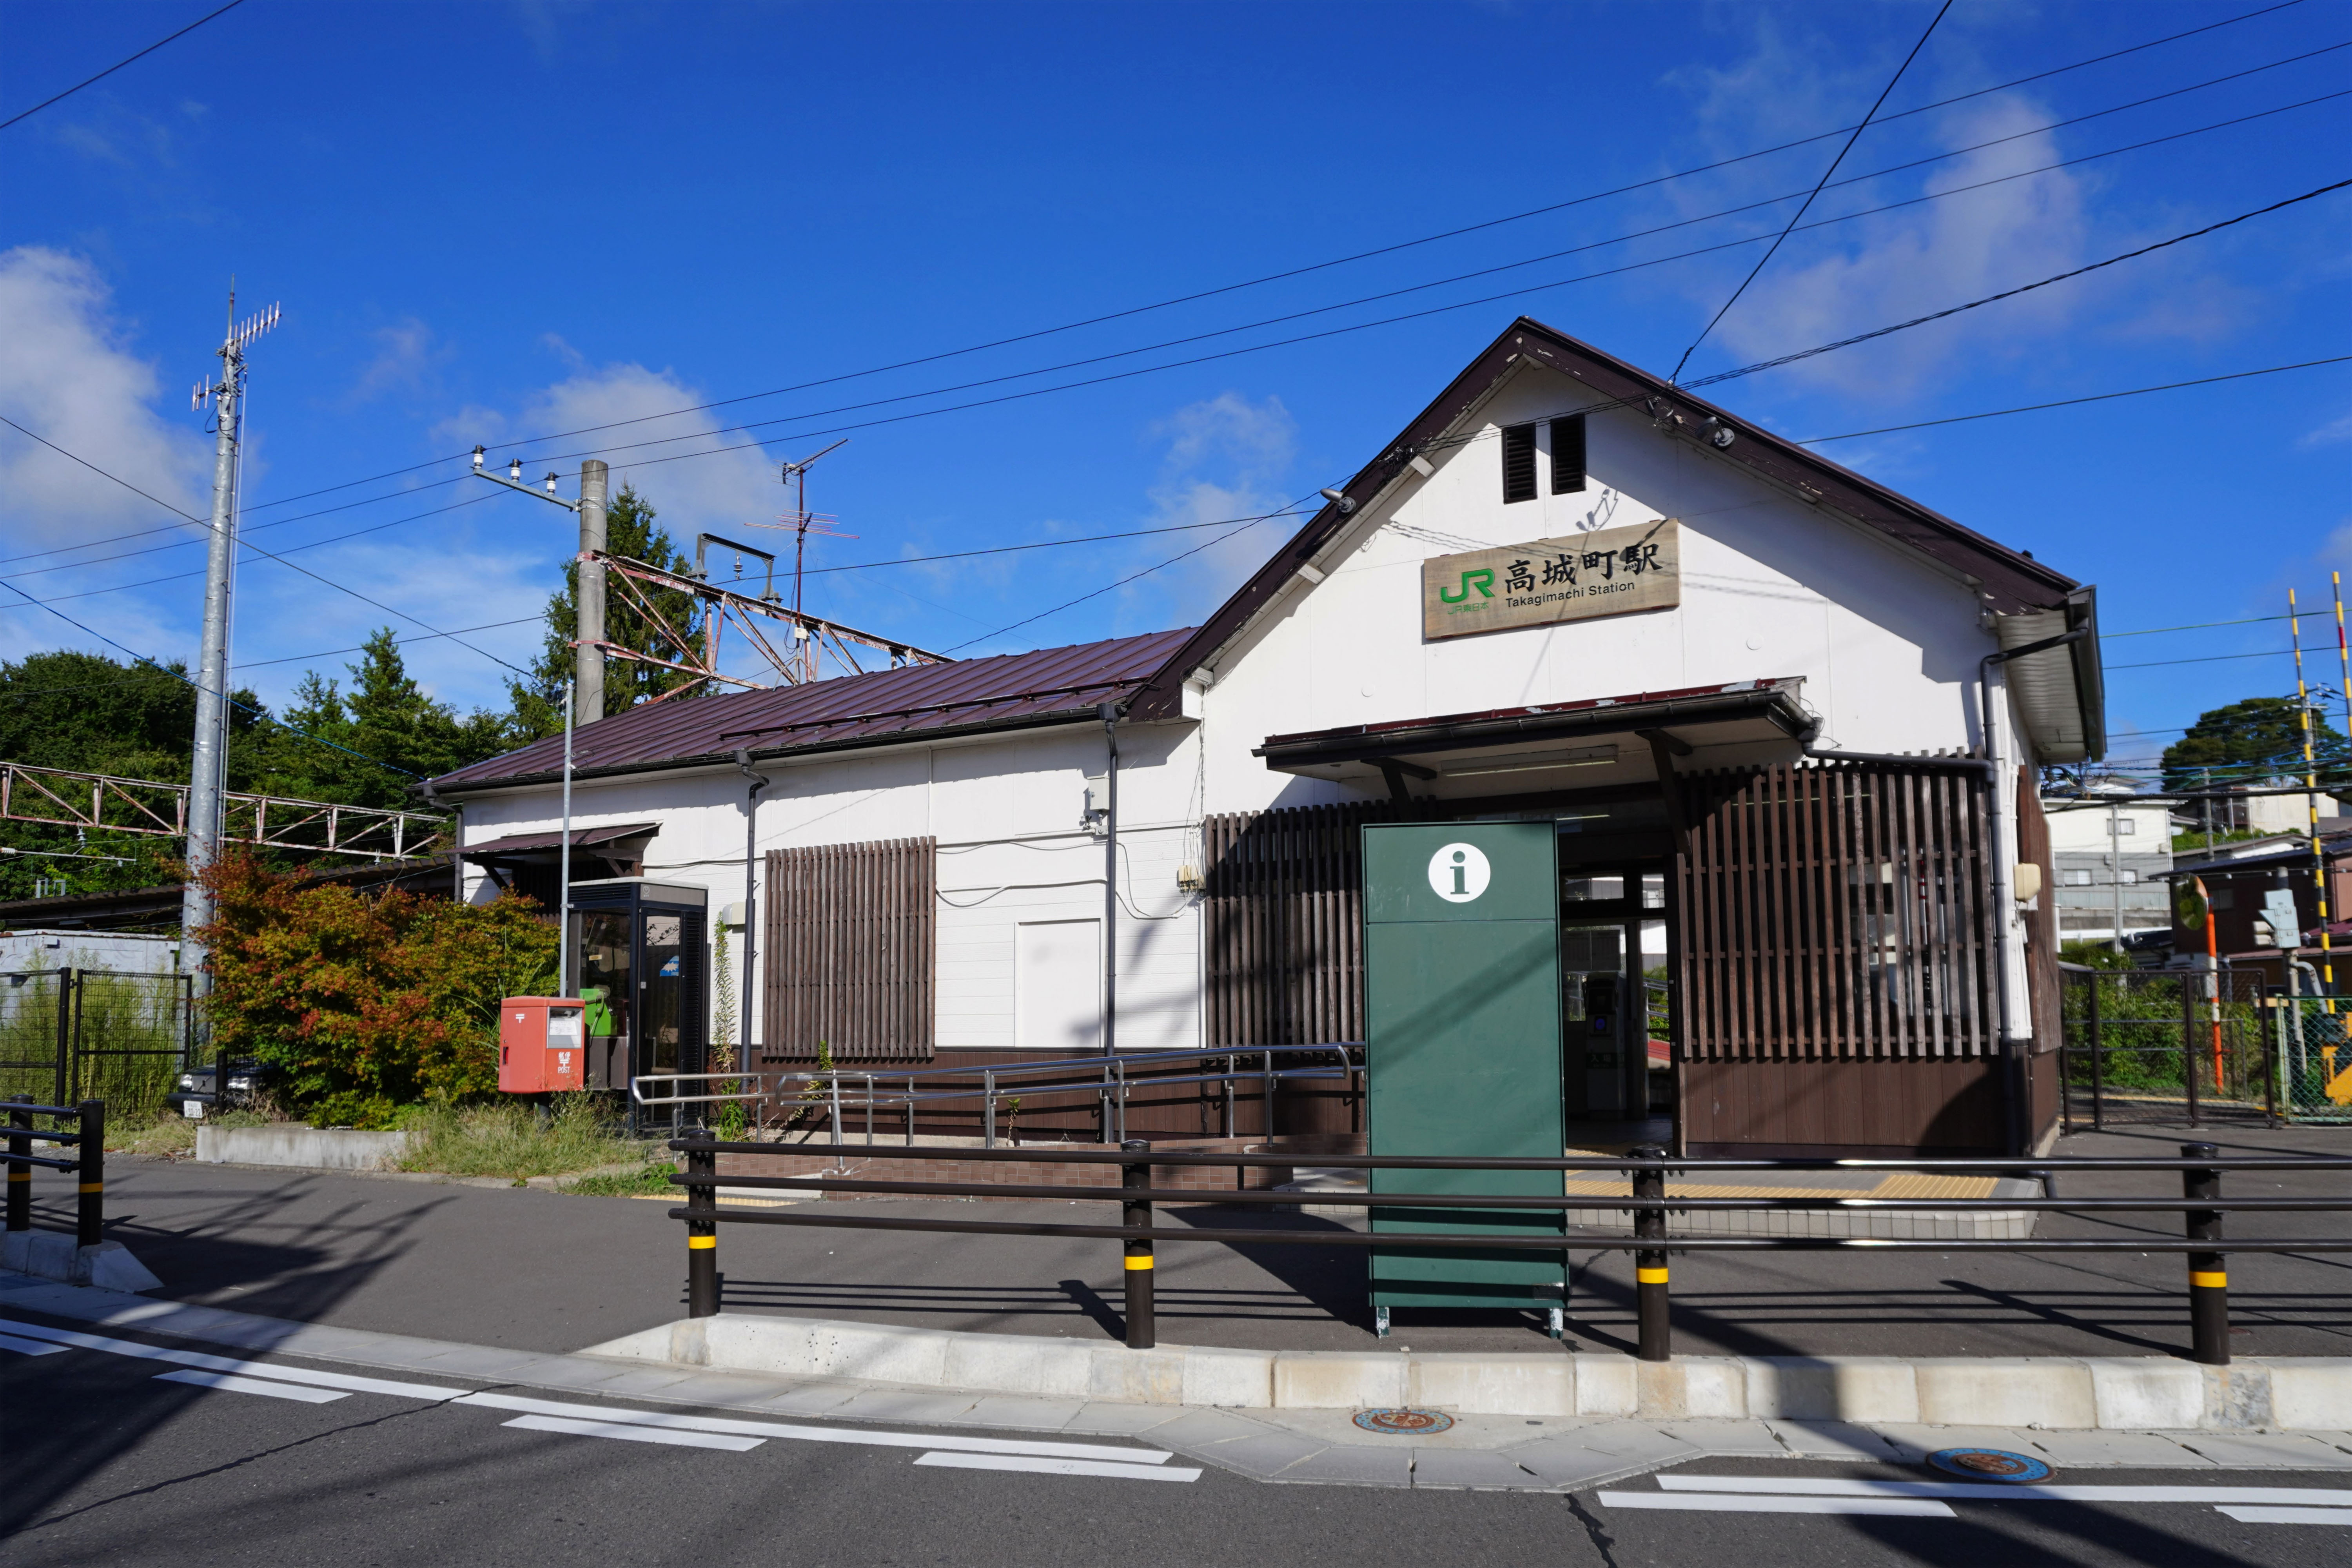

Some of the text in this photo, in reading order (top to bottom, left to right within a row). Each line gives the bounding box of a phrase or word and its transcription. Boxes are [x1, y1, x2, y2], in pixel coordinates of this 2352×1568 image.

[1505, 543, 1663, 593] 高城町駅
[1441, 568, 1495, 603] JR
[1506, 582, 1635, 607] Takagimachi Station
[1447, 601, 1489, 615] JR東日本
